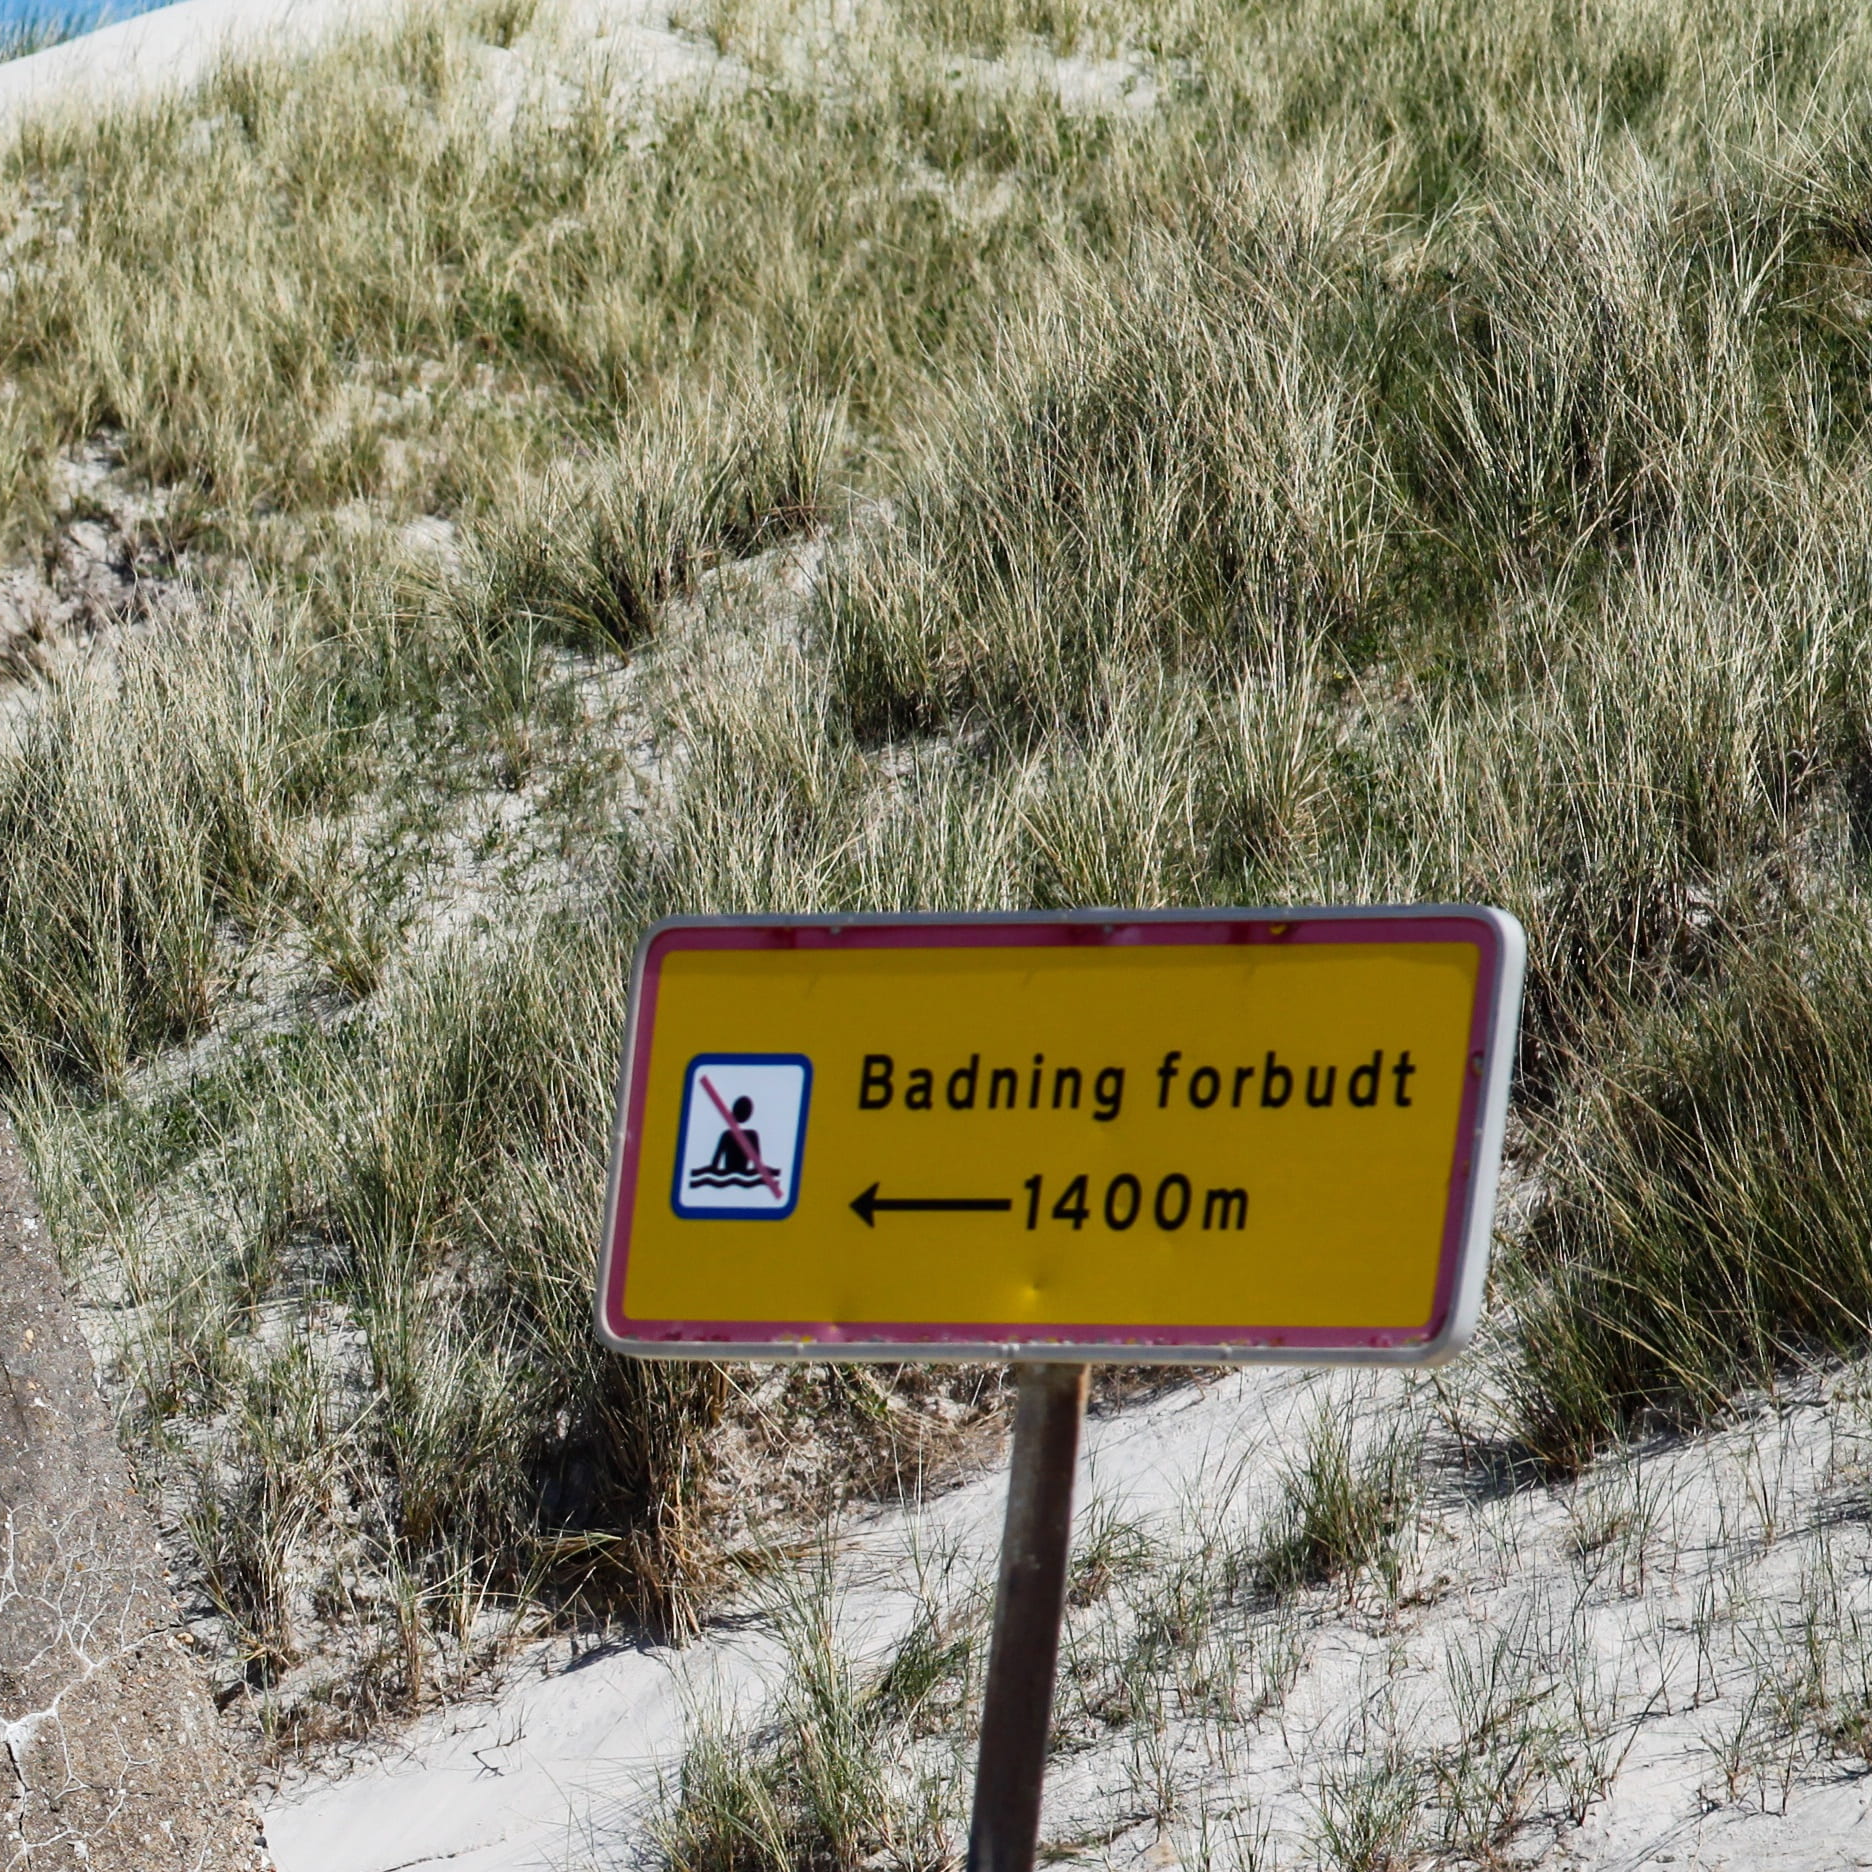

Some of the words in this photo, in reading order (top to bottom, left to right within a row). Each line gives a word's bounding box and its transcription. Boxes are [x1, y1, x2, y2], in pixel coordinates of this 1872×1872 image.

[858, 1053, 1125, 1123] Badning
[1153, 1049, 1417, 1110] forbudt
[1024, 1173, 1249, 1232] 1400m
